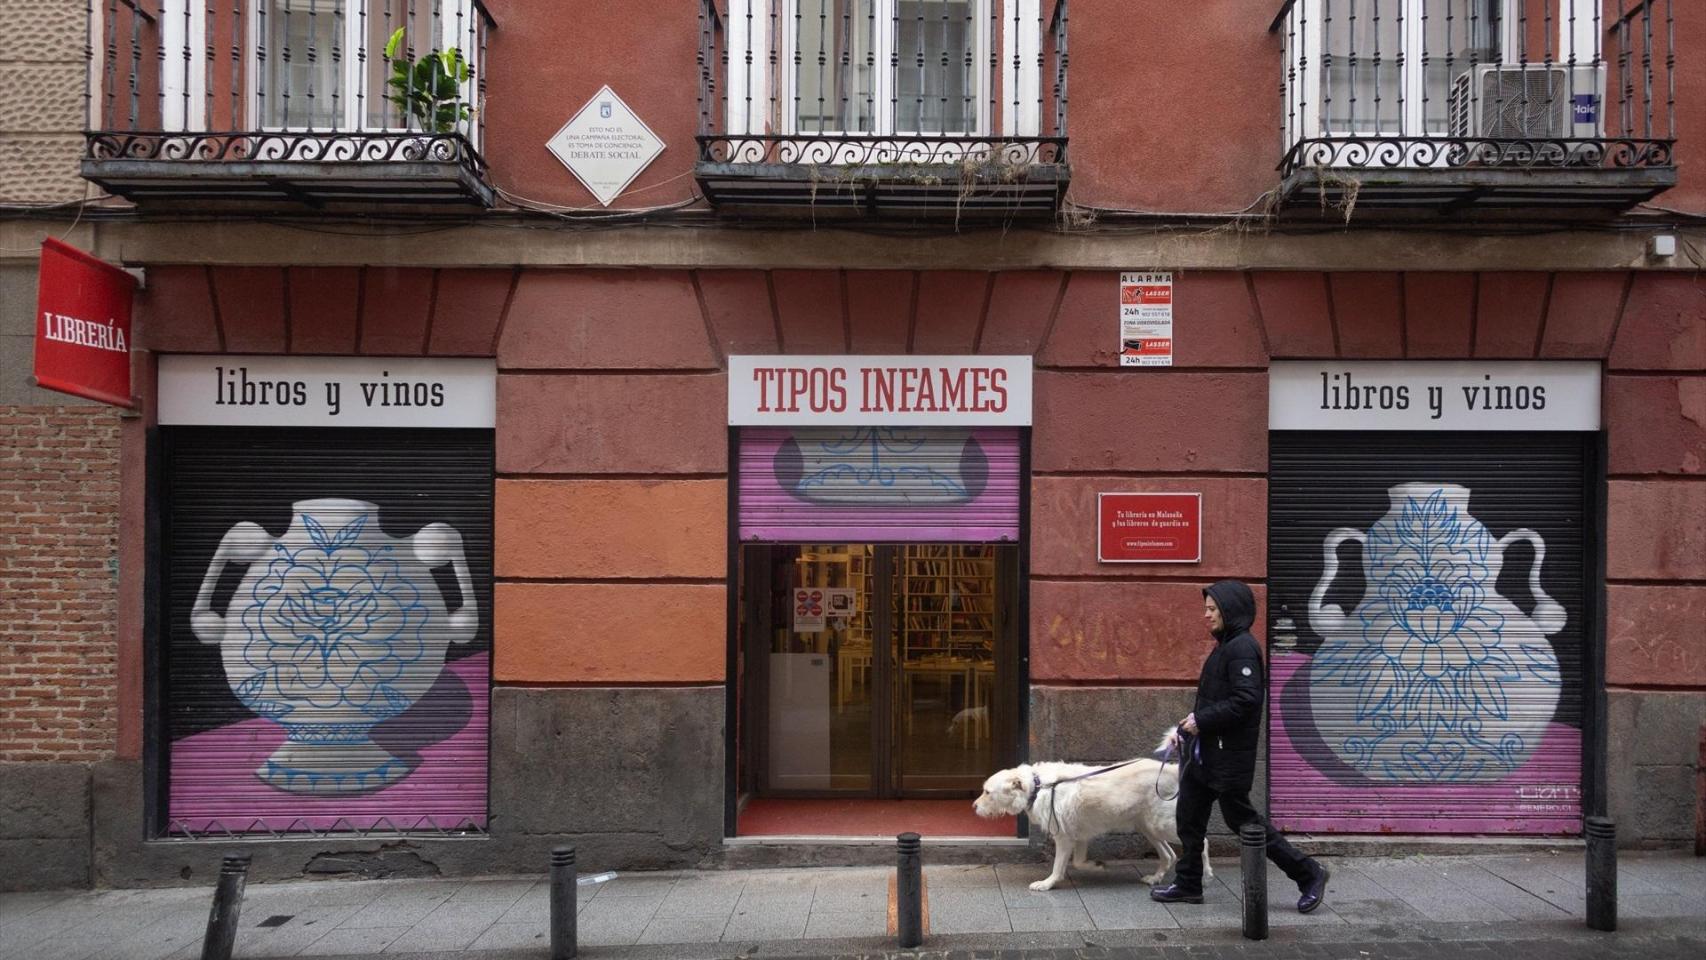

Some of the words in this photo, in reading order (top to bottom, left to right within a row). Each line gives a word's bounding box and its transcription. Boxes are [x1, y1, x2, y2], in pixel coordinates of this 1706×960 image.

[1574, 104, 1595, 114] Haie
[570, 151, 606, 159] DEBATE
[607, 151, 640, 159] SOCIAL
[1121, 275, 1171, 283] ALARMA
[44, 312, 127, 352] LIBRERÍA
[215, 367, 307, 406] libros
[325, 382, 341, 415] y
[360, 371, 445, 407] vinos
[753, 367, 847, 413] TIPOS
[860, 367, 1008, 413] INFAMES
[1320, 371, 1409, 410] libros
[1428, 385, 1443, 419] y
[1462, 374, 1546, 411] vinos
[1126, 519, 1149, 527] libreros
[1151, 519, 1158, 527] de
[1159, 519, 1181, 528] guardia
